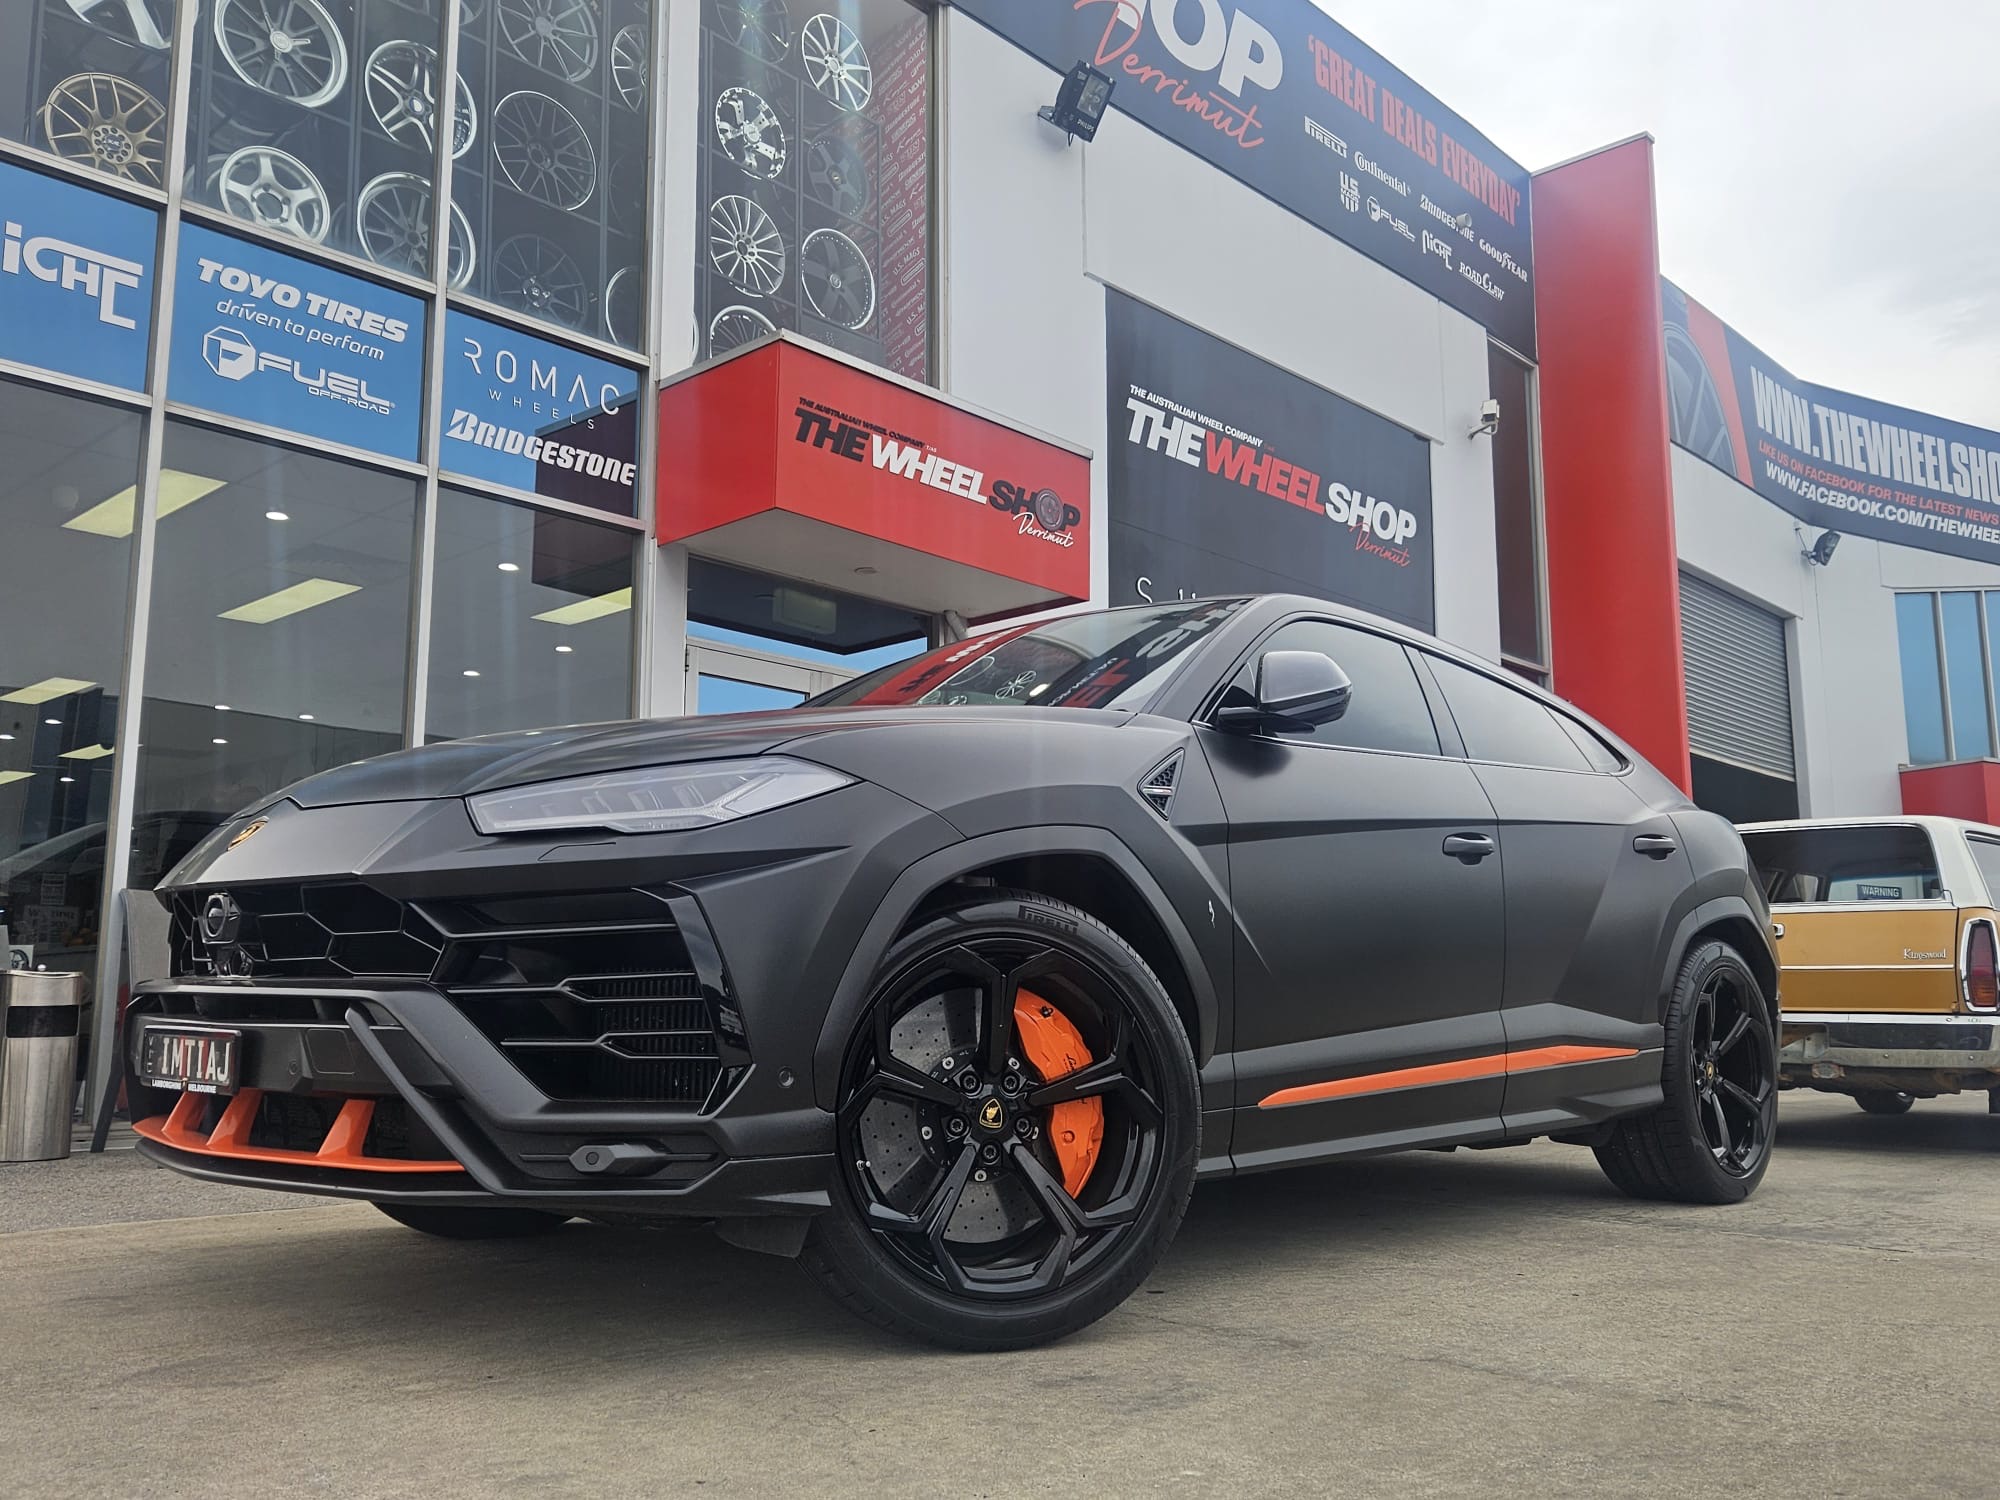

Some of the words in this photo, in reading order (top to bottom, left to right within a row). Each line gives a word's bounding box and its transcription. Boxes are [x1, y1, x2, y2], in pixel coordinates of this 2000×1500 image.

[1073, 0, 1265, 148] Derrimut
[1117, 0, 1283, 98] OP
[1077, 118, 1095, 132] PHILIPS
[1381, 87, 1438, 167] DEALS
[1304, 115, 1347, 159] PIRELLI
[1354, 151, 1408, 197] Continental
[1380, 208, 1416, 240] FUEL
[197, 257, 301, 309] TOYO
[305, 292, 409, 343] TIRES
[216, 299, 281, 330] driven
[284, 318, 305, 336] to
[306, 328, 385, 361] perform
[257, 351, 391, 408] FUEL
[307, 386, 390, 416] OFF-ROAD
[463, 337, 621, 416] ROMAC
[488, 388, 595, 430] WHEELS
[798, 396, 814, 409] THE
[814, 402, 862, 427] AUSTRALIAN
[862, 420, 888, 436] WHEEL
[888, 431, 926, 449] COMPANY
[1130, 384, 1147, 399] THE
[1147, 392, 1198, 421] AUSTRALIAN
[1197, 413, 1224, 432] WHEEL
[1224, 425, 1263, 448] COMPANY
[445, 408, 637, 487] BRIDGESTONE
[795, 407, 871, 463] THE
[872, 434, 988, 505] WHEEL
[1126, 397, 1207, 468] THE
[1205, 430, 1325, 516] WHEEL
[1325, 482, 1417, 545] SHOP
[1759, 440, 1776, 460] LIKE
[1777, 450, 1789, 466] US
[1790, 458, 1804, 475] ON
[1805, 465, 1866, 494] FACEBOOK
[1868, 485, 1892, 500] FOR
[1895, 490, 1917, 506] THE
[1919, 496, 1964, 517] LATEST
[1965, 508, 2000, 526] NEWS
[1012, 511, 1074, 548] Derrimut
[1348, 521, 1411, 568] Derrimut
[1018, 905, 1079, 936] PIRELLI
[1861, 886, 1900, 898] WARNING
[1903, 948, 1946, 960] Kingswood
[161, 1037, 232, 1082] IMTIAJ
